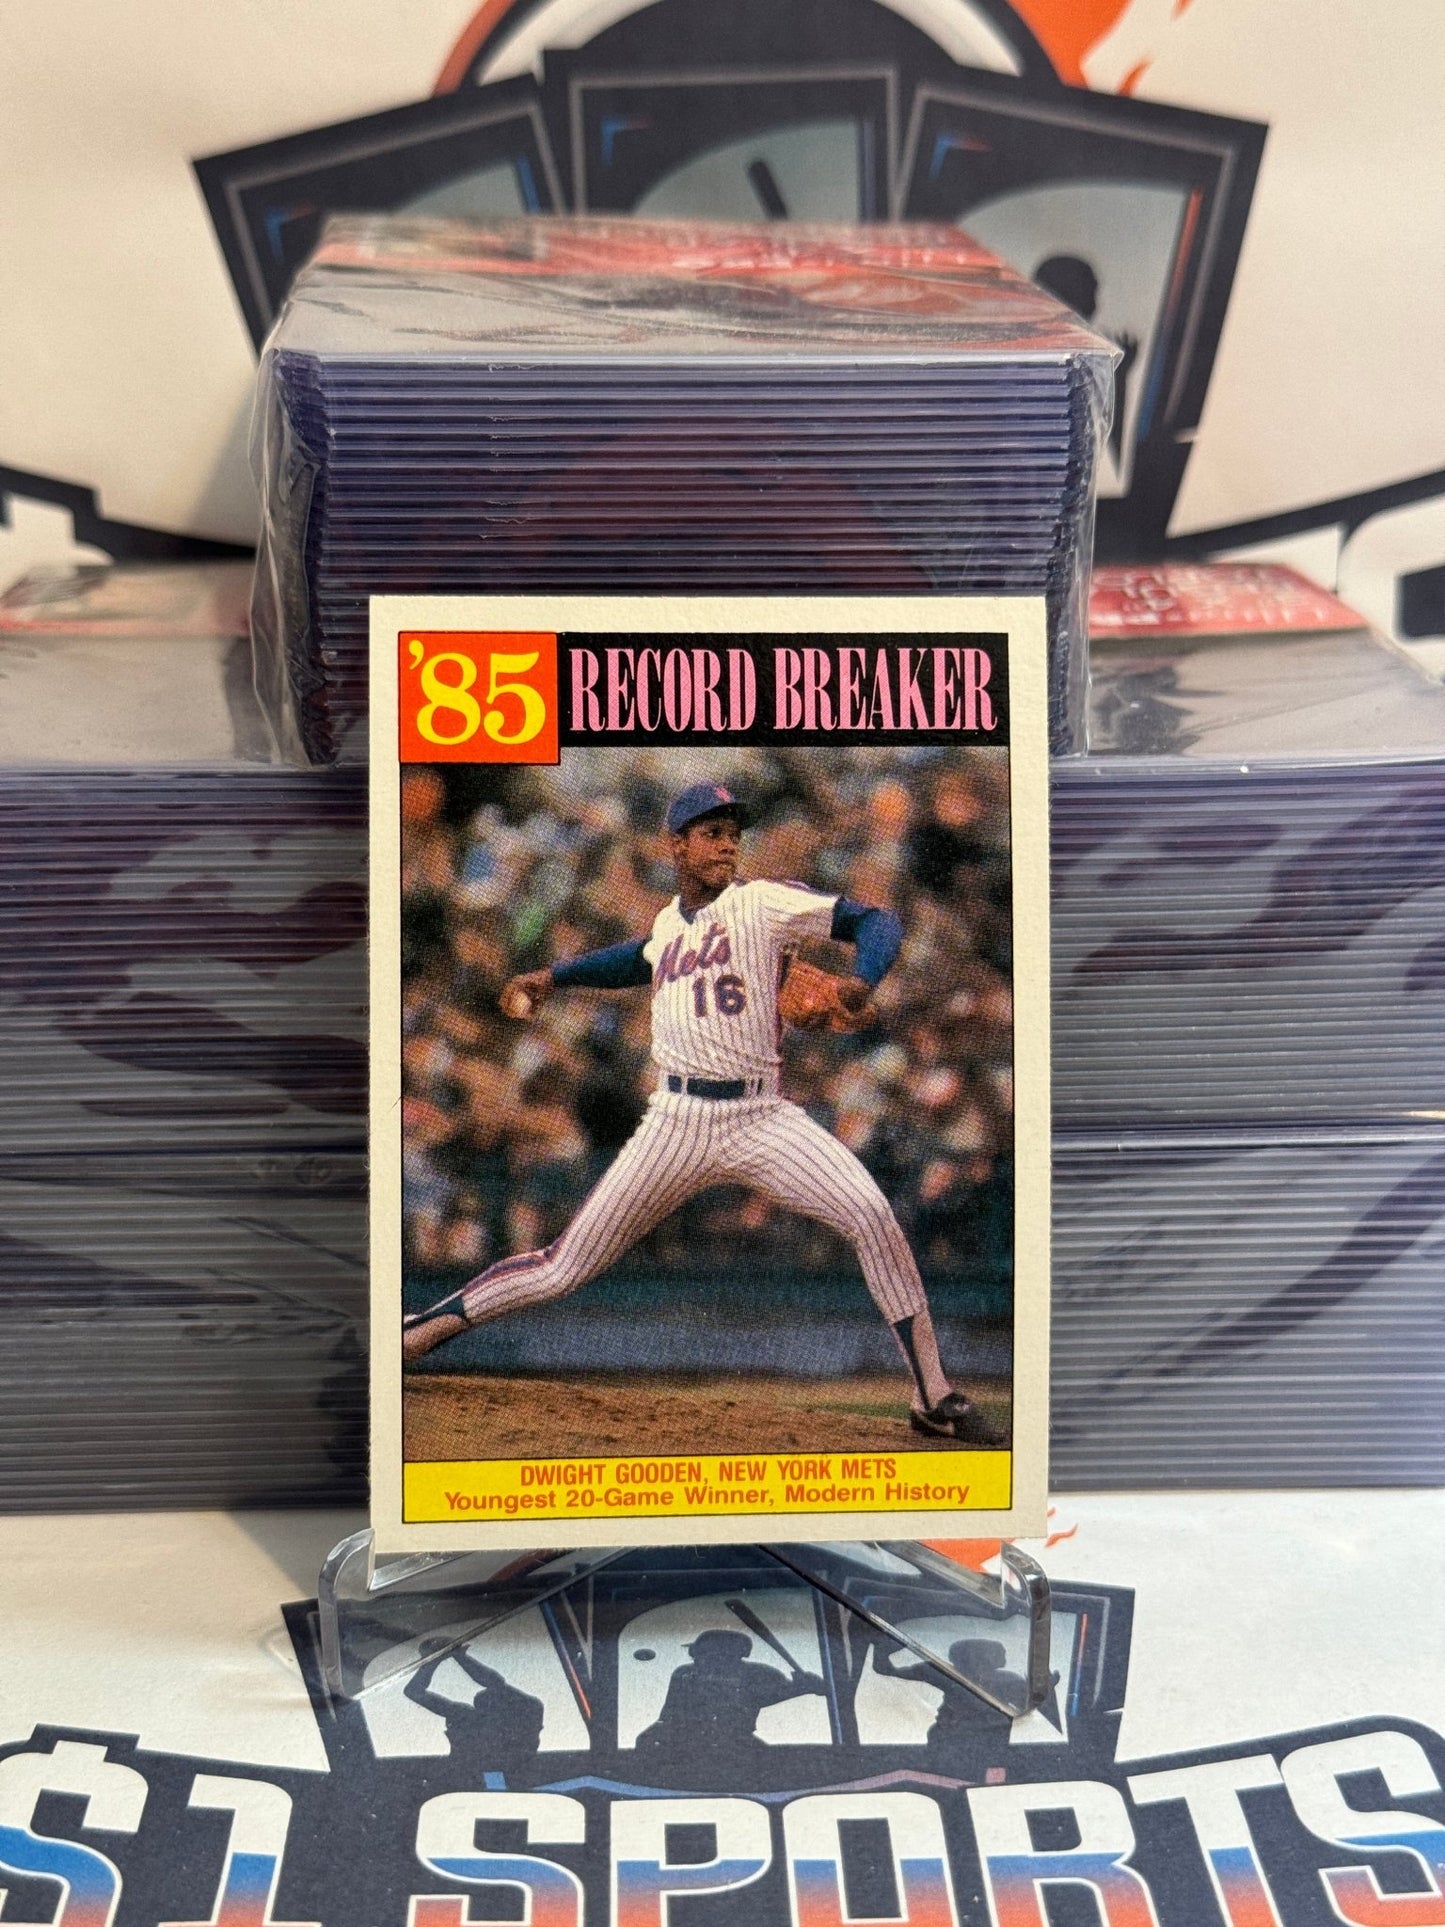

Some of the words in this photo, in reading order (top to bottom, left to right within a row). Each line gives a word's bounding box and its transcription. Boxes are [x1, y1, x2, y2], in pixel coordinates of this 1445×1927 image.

[409, 640, 546, 745] '85
[569, 647, 756, 732] RECORD
[773, 647, 998, 732] BREAKER
[651, 922, 731, 996] Mets
[692, 974, 747, 1018] 16
[444, 1489, 556, 1514] Youngest
[566, 1487, 675, 1508] 20-Game
[684, 1485, 775, 1507] Winner,
[785, 1484, 875, 1504] Modern
[885, 1482, 970, 1504] History
[520, 1464, 607, 1487] DWIGHT
[615, 1461, 709, 1485] GOODEN,
[718, 1460, 768, 1482] NEW
[777, 1458, 833, 1481] YORK
[841, 1457, 897, 1480] METS
[408, 1731, 1445, 1927] SPORTS
